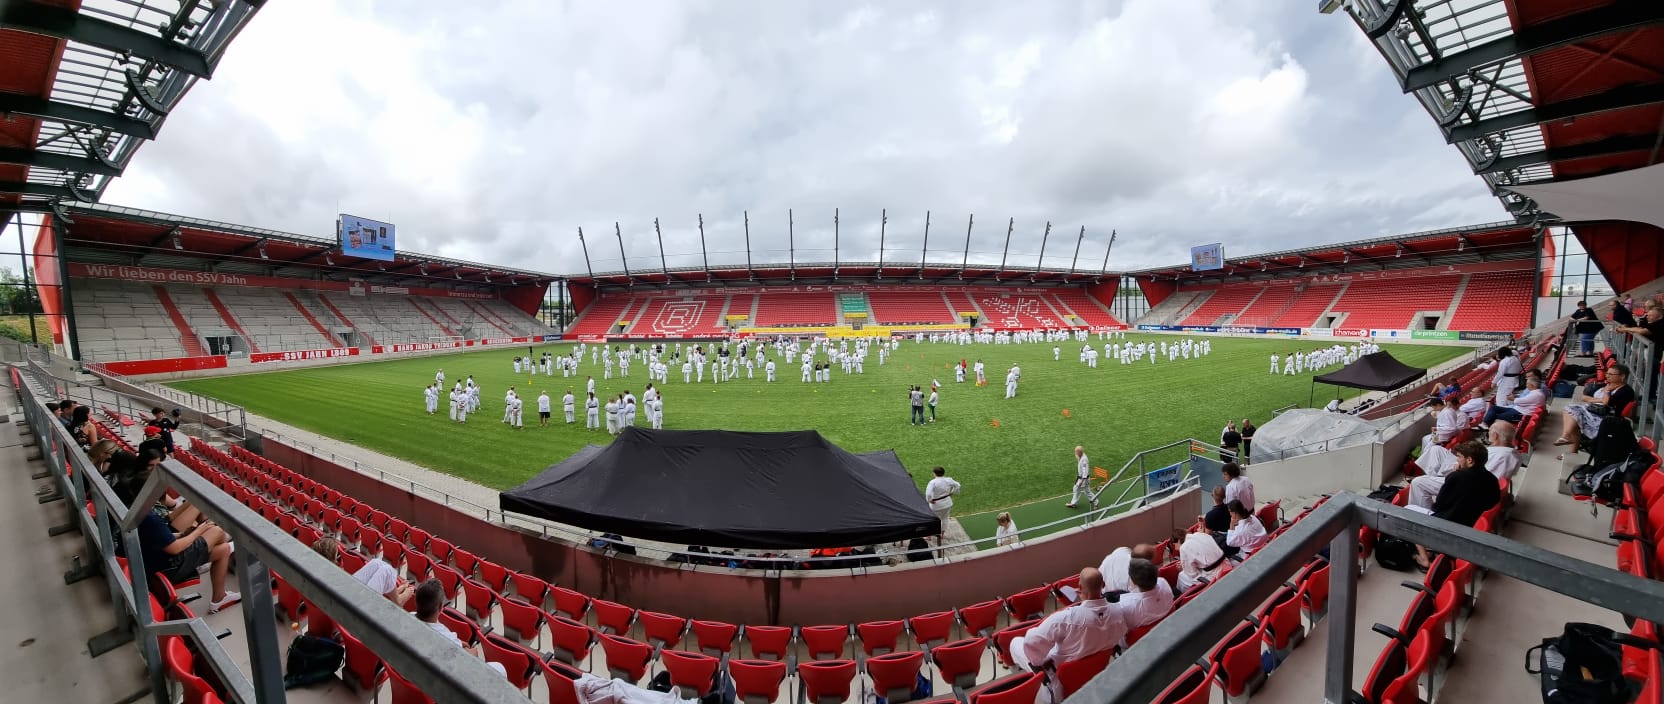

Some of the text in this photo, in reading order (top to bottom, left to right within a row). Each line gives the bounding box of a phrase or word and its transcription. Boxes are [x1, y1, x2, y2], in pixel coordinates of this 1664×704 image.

[86, 265, 247, 285] Wir lieben den SSV Jahn
[284, 351, 302, 360] SSV
[305, 350, 327, 359] JAHN
